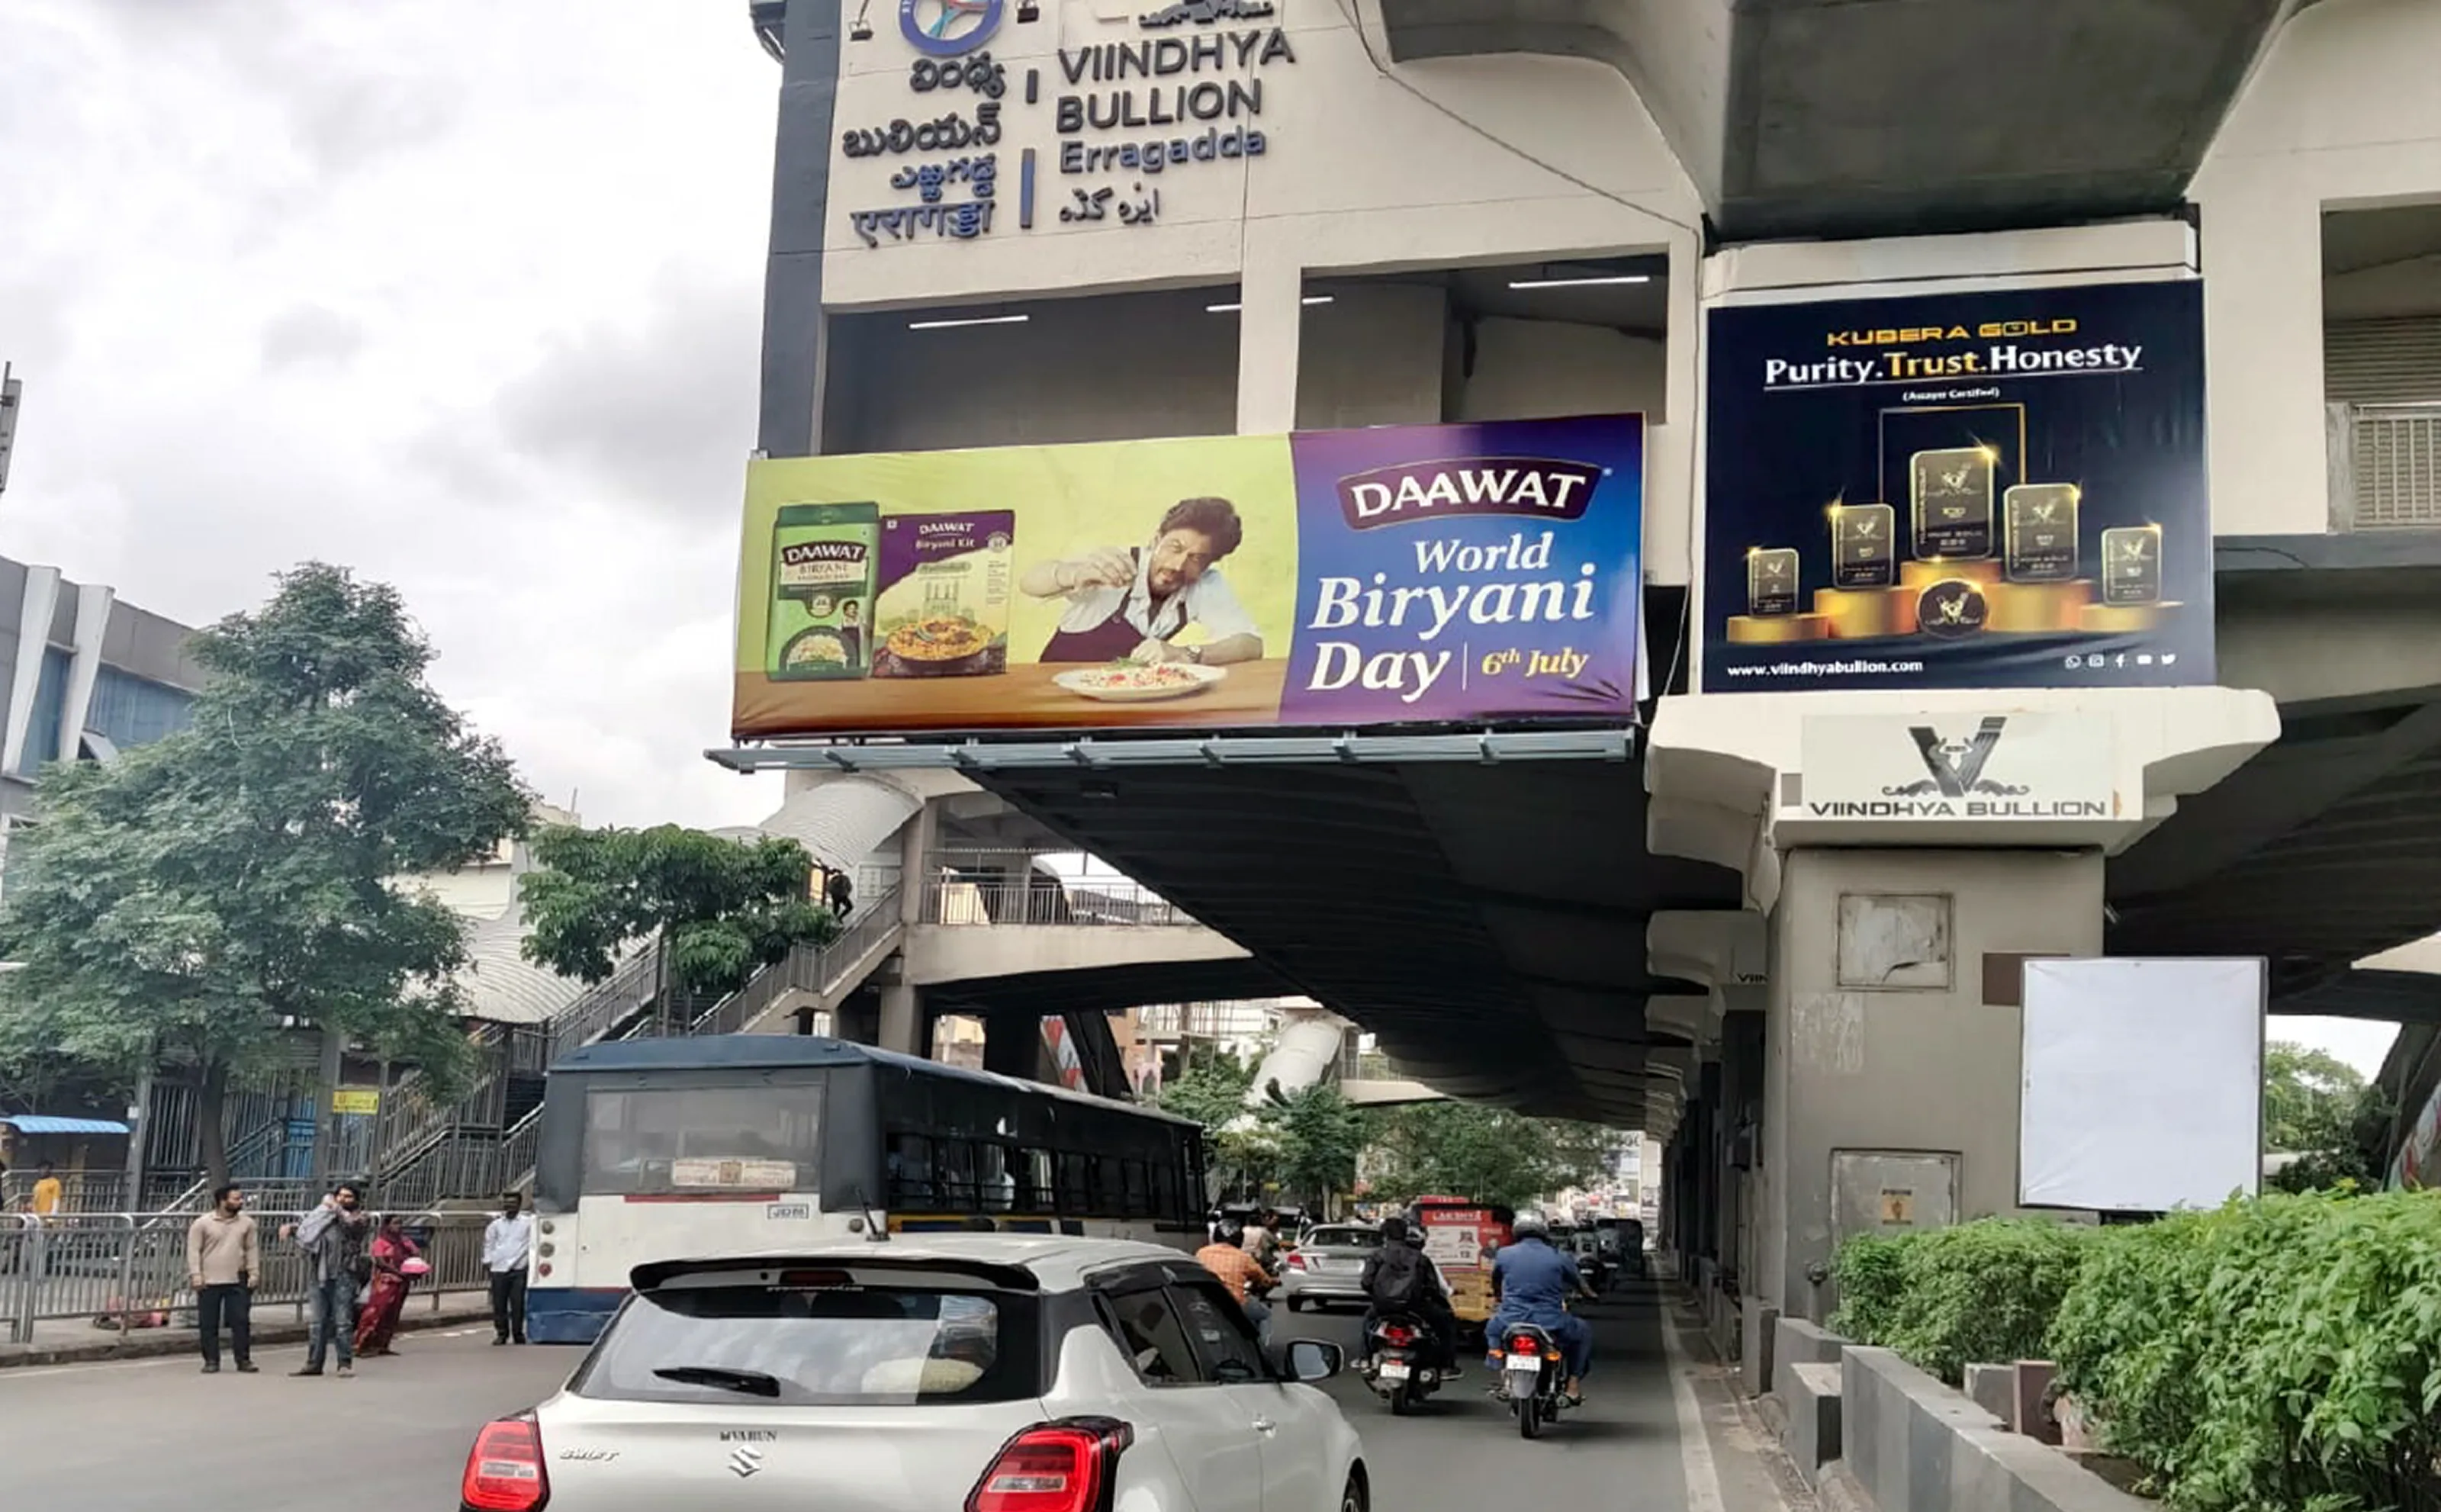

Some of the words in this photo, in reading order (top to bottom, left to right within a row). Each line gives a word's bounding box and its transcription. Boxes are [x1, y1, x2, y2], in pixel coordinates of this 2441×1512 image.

[1058, 27, 1296, 85] VIINDHYA
[1056, 78, 1263, 133] BULLION
[843, 102, 1001, 157] బులియన్
[1060, 124, 1266, 174] Erragadda
[1827, 327, 1970, 346] KUBERA
[1979, 319, 2078, 337] GOLD
[1351, 469, 1586, 517] DAAWAT
[786, 545, 864, 564] DAAWAT
[1414, 531, 1555, 573] World
[1307, 562, 1596, 640] Biryani
[1306, 642, 1452, 703] Day
[1481, 648, 1521, 675] 6th
[1525, 647, 1590, 679] July
[1727, 659, 1923, 677] www.viindhyabullion.com
[1809, 802, 1956, 816] VIINDHYA
[1967, 802, 2107, 816] BULLION
[732, 1430, 777, 1441] VARUN
